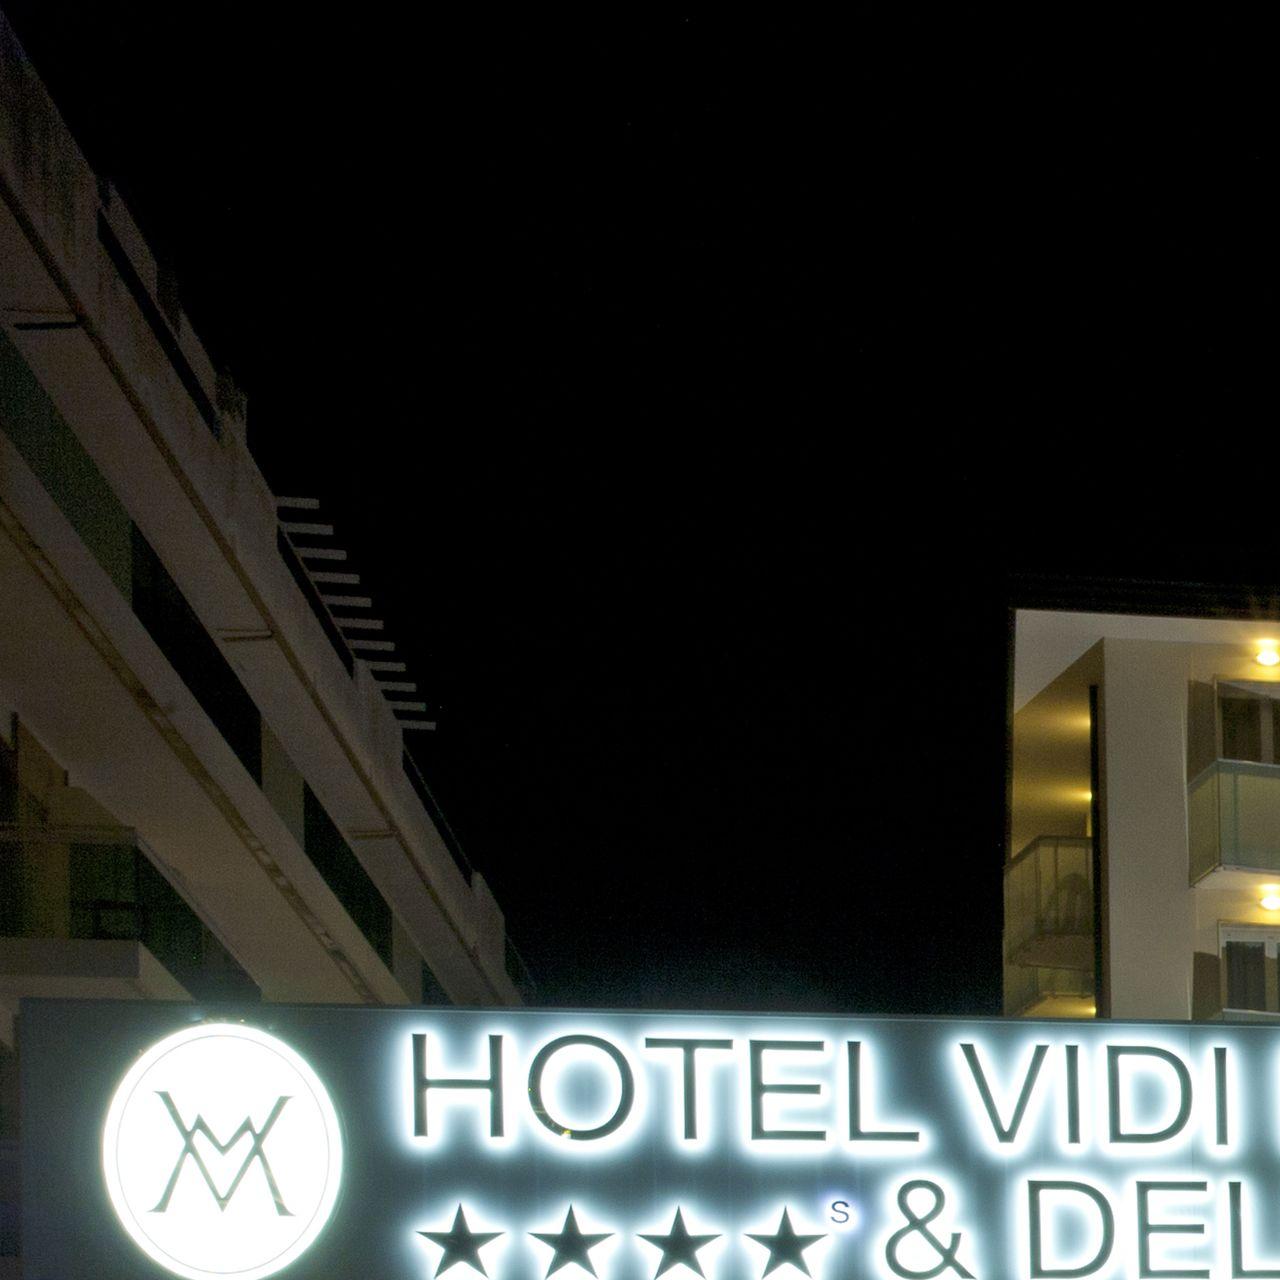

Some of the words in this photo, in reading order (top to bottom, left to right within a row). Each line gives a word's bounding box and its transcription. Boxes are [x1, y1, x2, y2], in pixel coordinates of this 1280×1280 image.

[409, 1032, 921, 1142] HOTEL
[959, 1042, 1229, 1147] VIDI
[885, 1179, 978, 1280] &
